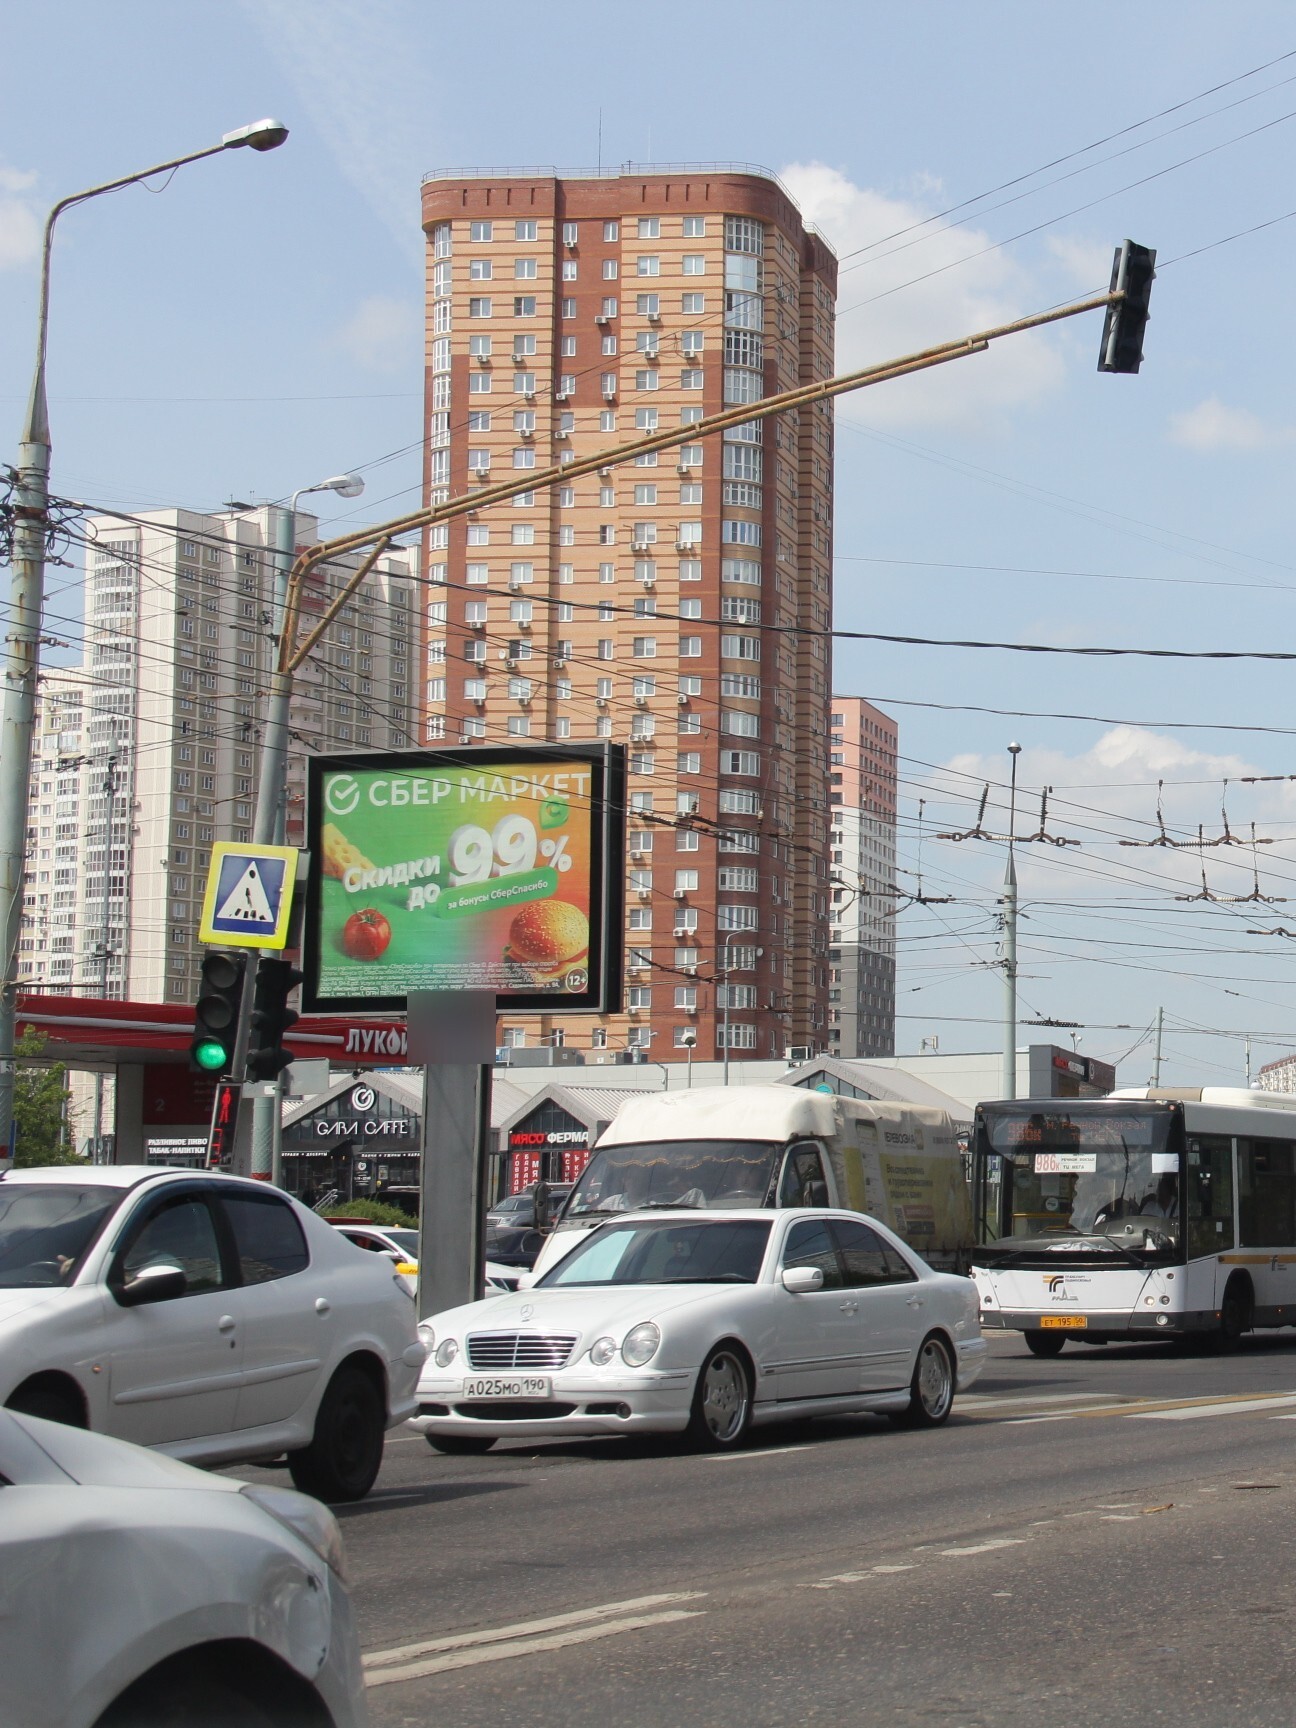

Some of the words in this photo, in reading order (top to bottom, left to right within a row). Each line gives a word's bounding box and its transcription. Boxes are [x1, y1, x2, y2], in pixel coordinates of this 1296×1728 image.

[369, 778, 451, 806] СБЕР
[460, 773, 592, 803] МАРКЕТ
[407, 883, 441, 911] до
[459, 892, 489, 909] бонусы
[491, 880, 549, 899] СберСпасибо
[569, 975, 587, 986] 12+
[1057, 1317, 1072, 1326] 195
[523, 1379, 545, 1391] 190
